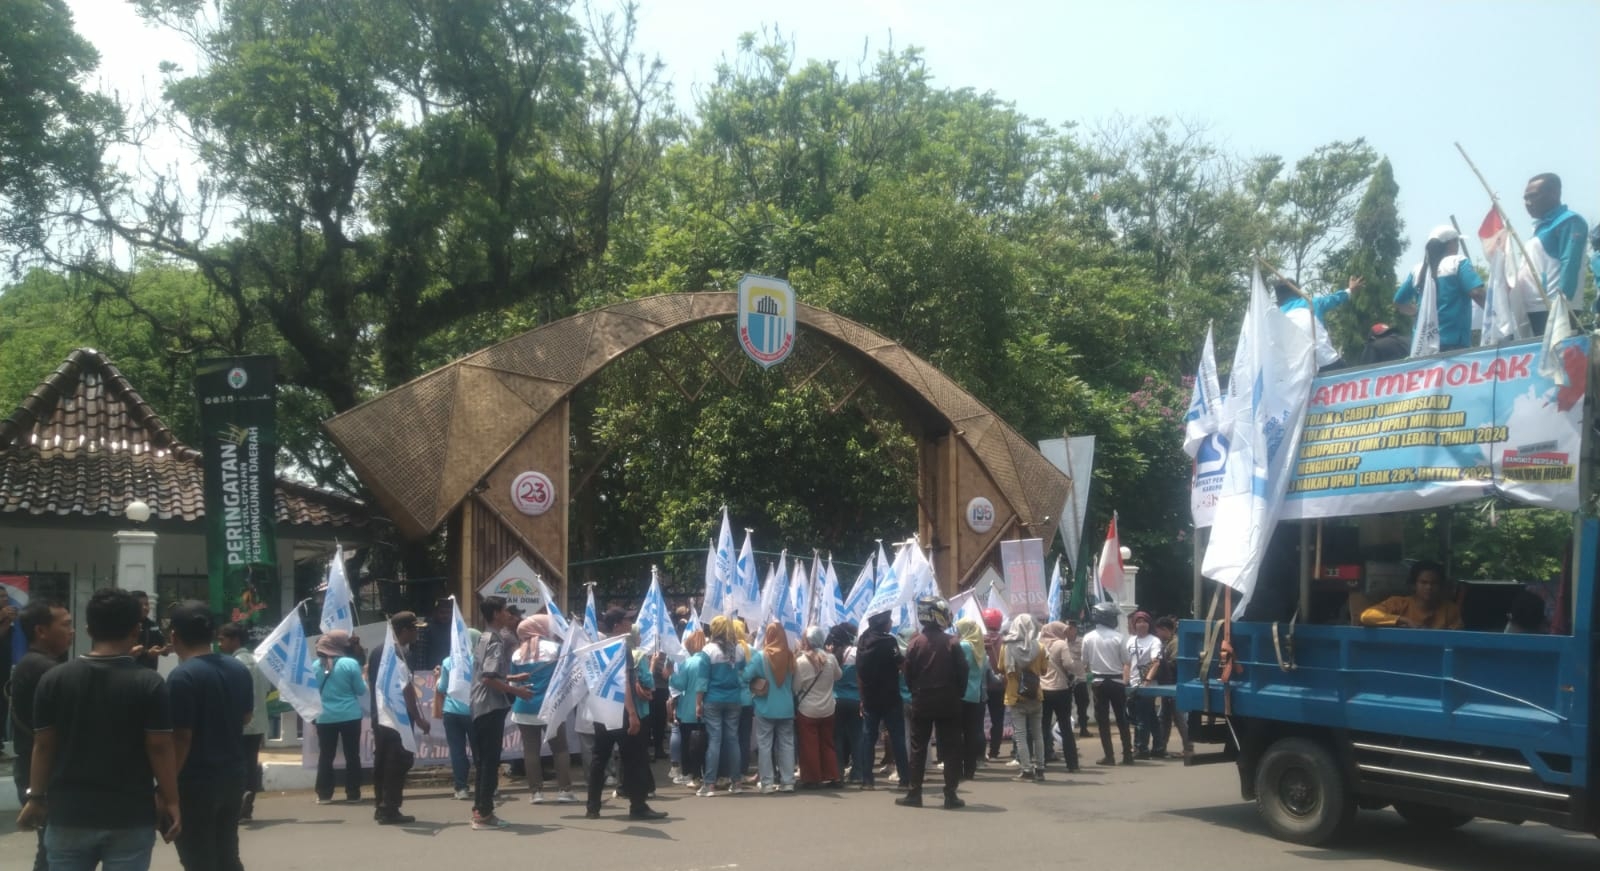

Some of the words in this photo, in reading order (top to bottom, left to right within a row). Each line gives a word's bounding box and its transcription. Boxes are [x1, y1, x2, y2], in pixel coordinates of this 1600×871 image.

[1307, 378, 1371, 408] AMI
[1375, 353, 1534, 398] MENOLAK
[1305, 411, 1334, 426] TOLAK
[1343, 405, 1376, 421] CABUT
[1377, 395, 1451, 417] OMNIBUSLAW
[1303, 428, 1332, 442] TOLAK
[1332, 422, 1380, 439] KENAIKAN
[1381, 417, 1408, 432] UPAH
[1409, 411, 1466, 429] MINIMUM
[1388, 434, 1400, 448] DI
[1401, 431, 1437, 446] LEBAK
[1439, 429, 1475, 445] TAHUN
[1476, 426, 1509, 443] 2024
[248, 427, 259, 473] DAERAH
[1346, 456, 1362, 470] PP
[521, 481, 547, 503] 23
[1296, 475, 1329, 492] NAIKAN
[1330, 473, 1356, 489] UPAH
[1359, 470, 1390, 486] LEBAK
[1391, 467, 1415, 482] 28%
[1417, 467, 1461, 480] UNTUK
[220, 443, 245, 565] PERINGATAN
[249, 475, 261, 563] PEMBANGUNAN
[973, 505, 992, 520] 195
